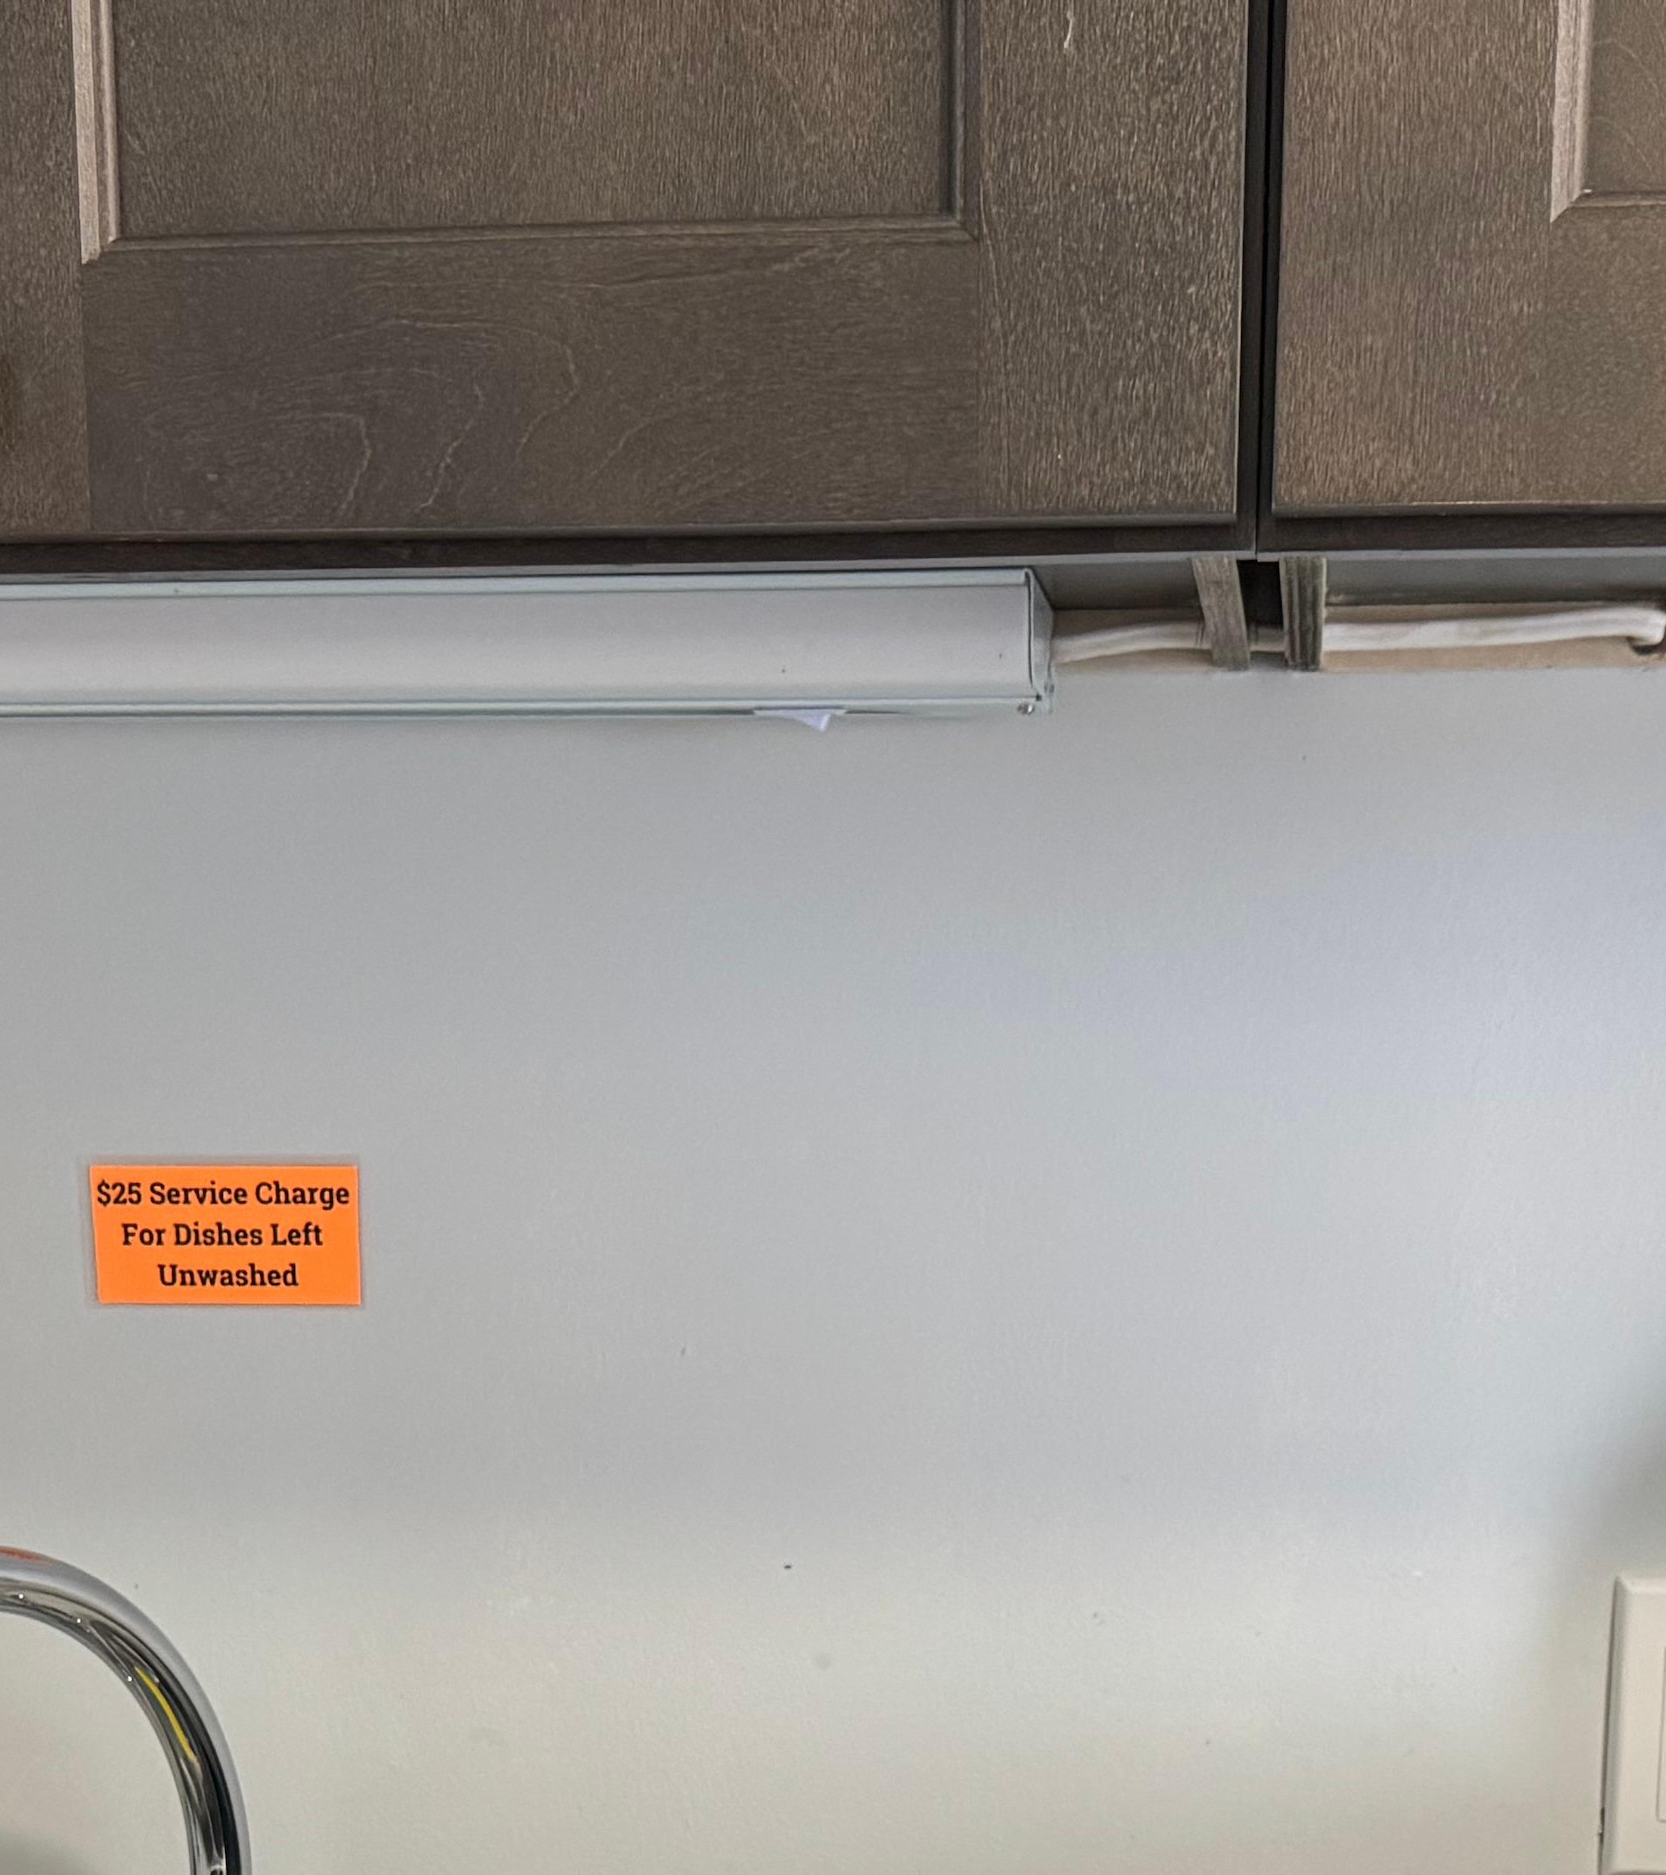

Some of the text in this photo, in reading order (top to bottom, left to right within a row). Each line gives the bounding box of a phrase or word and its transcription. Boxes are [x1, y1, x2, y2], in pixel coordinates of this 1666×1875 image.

[97, 1178, 350, 1211] $25 Service Charge
[122, 1221, 323, 1246] For Dishes Left
[157, 1263, 300, 1287] Unwashed
